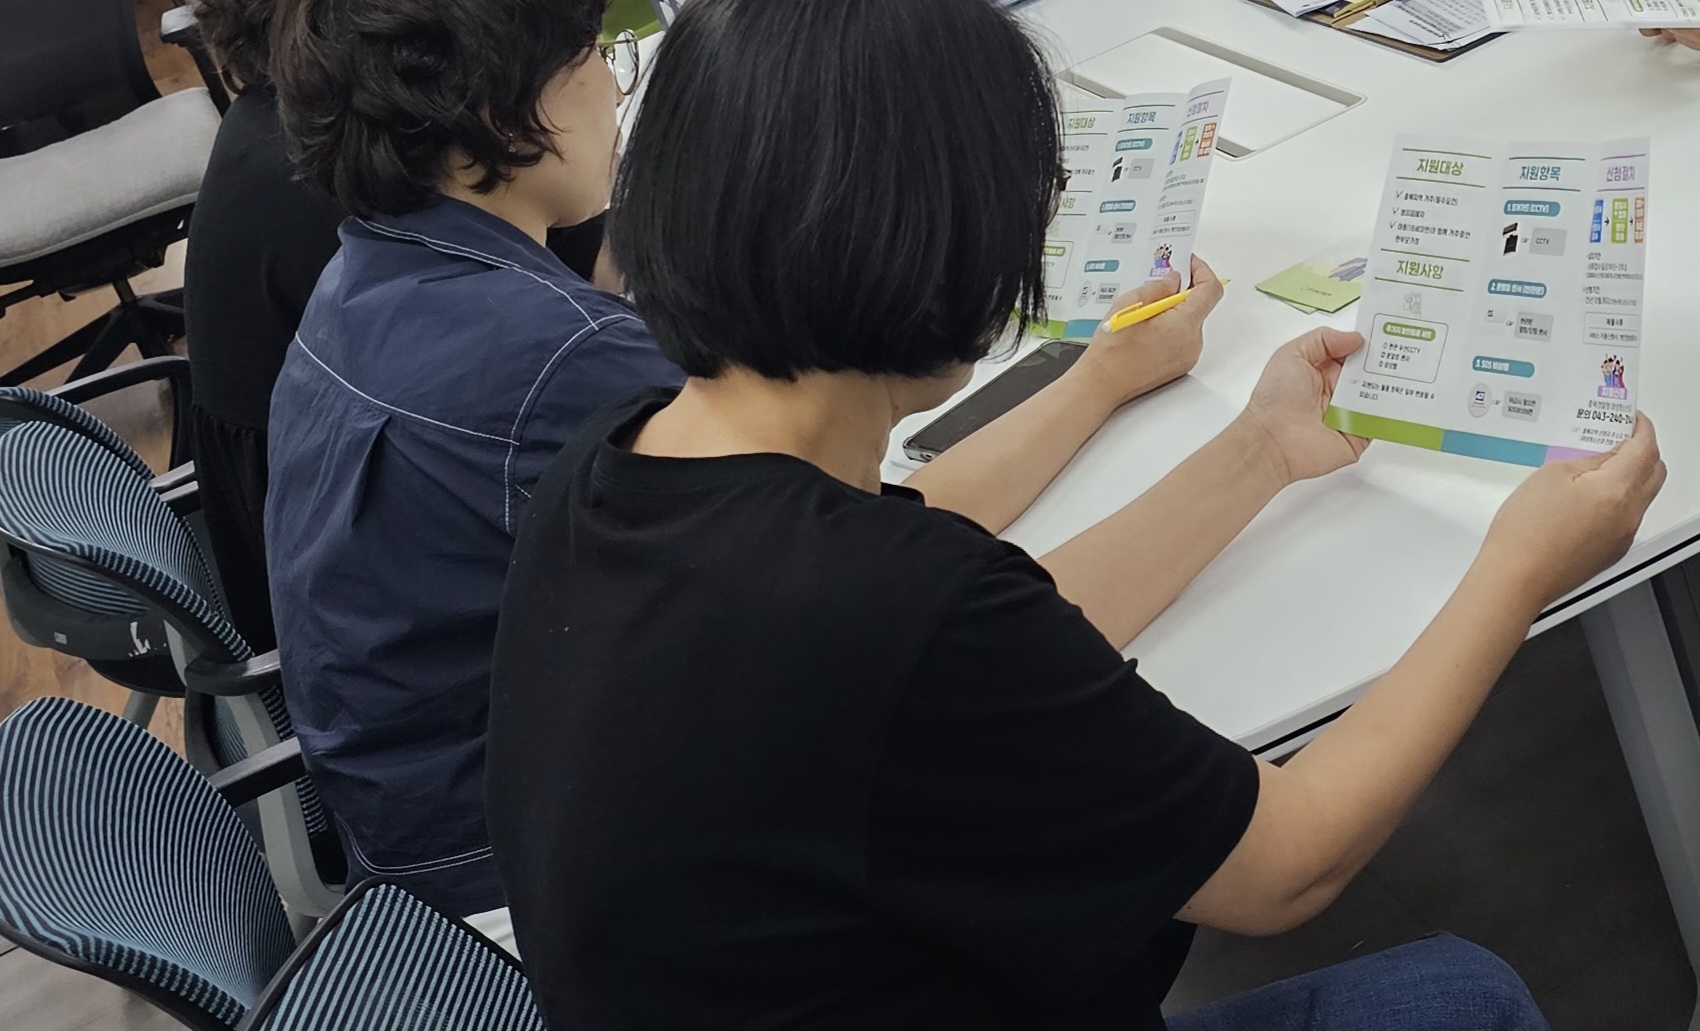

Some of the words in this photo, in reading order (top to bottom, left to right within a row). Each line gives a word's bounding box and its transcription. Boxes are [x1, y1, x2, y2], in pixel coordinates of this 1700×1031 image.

[1417, 158, 1464, 176] 지원대상
[1520, 166, 1561, 181] 지원항목
[1607, 166, 1635, 182] 신청절차
[1396, 260, 1444, 280] 지원사항
[1576, 408, 1591, 419] 문의
